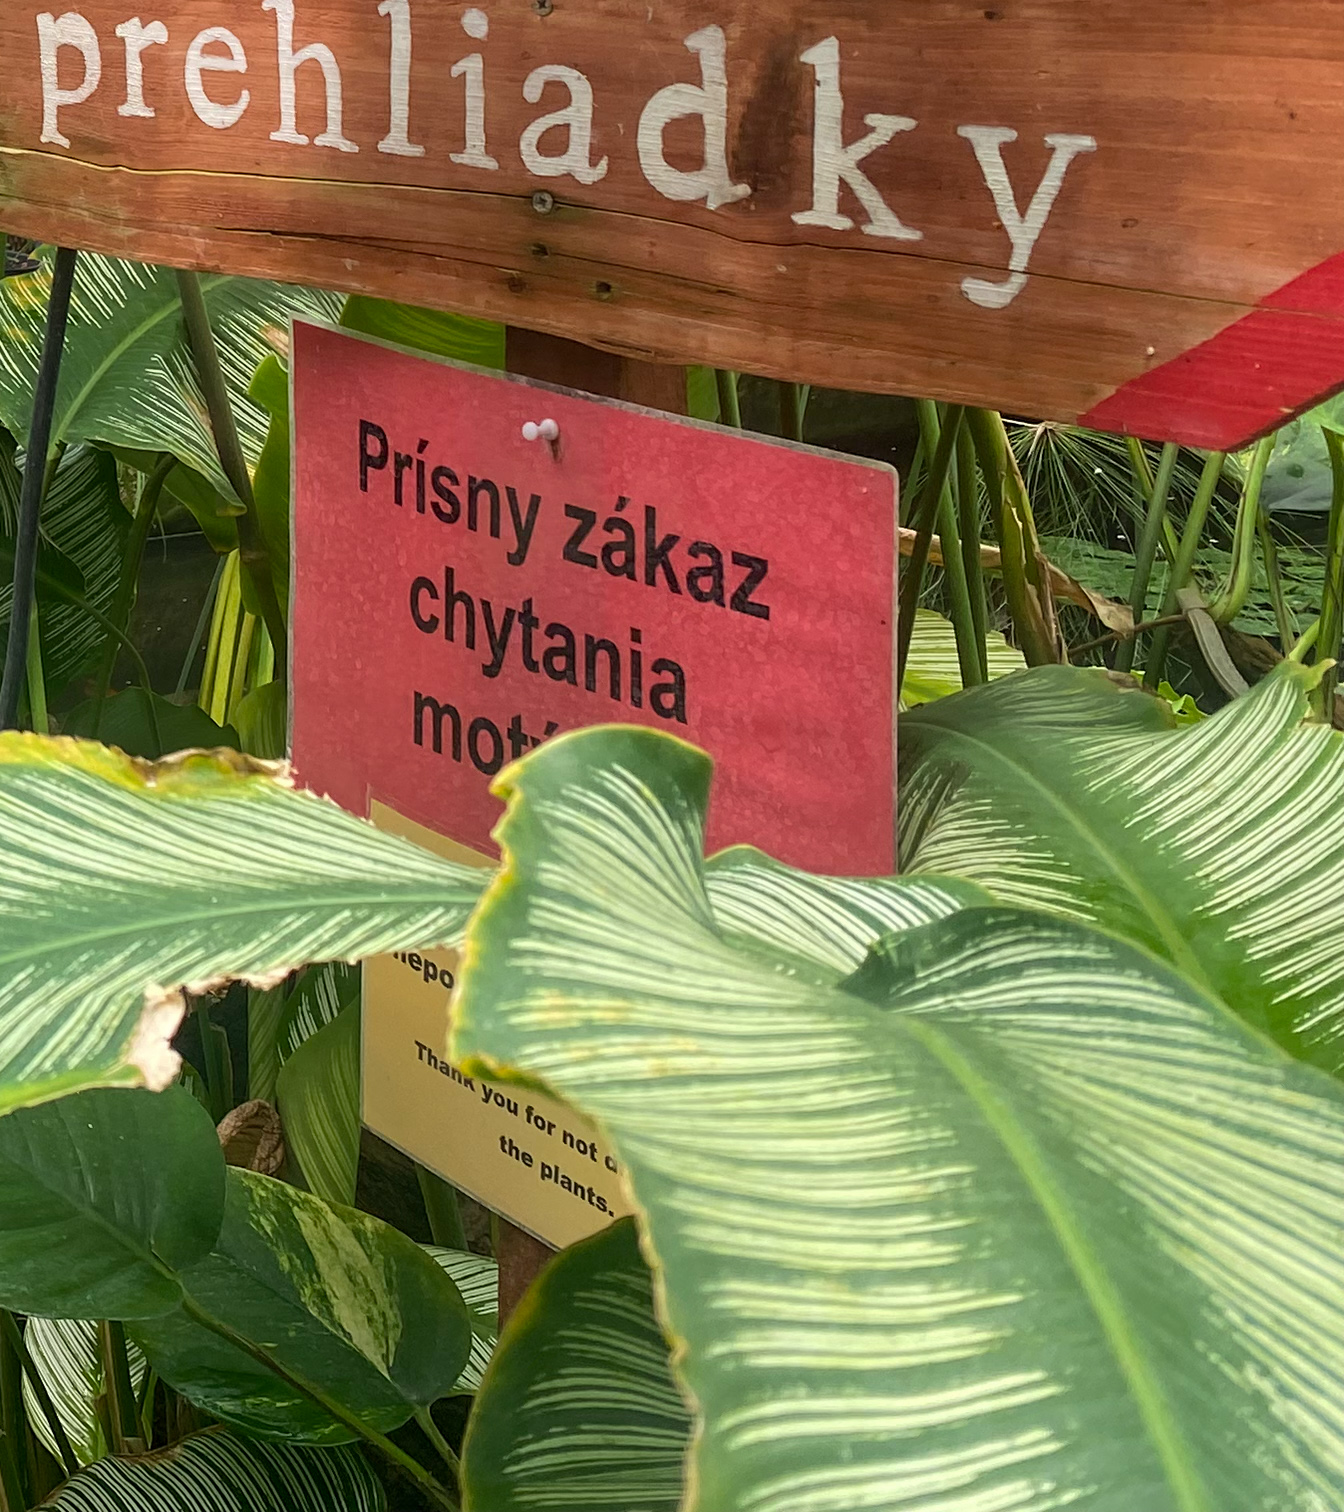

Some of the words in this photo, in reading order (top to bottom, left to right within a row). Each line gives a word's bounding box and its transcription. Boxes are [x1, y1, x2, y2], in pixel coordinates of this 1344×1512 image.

[358, 419, 541, 565] Prísny
[563, 495, 770, 620] zákaz
[409, 567, 688, 724] chytania
[481, 1083, 518, 1117] you
[525, 1105, 556, 1136] for
[562, 1130, 598, 1162] not
[500, 1135, 534, 1168] the
[540, 1161, 614, 1218] plants.
